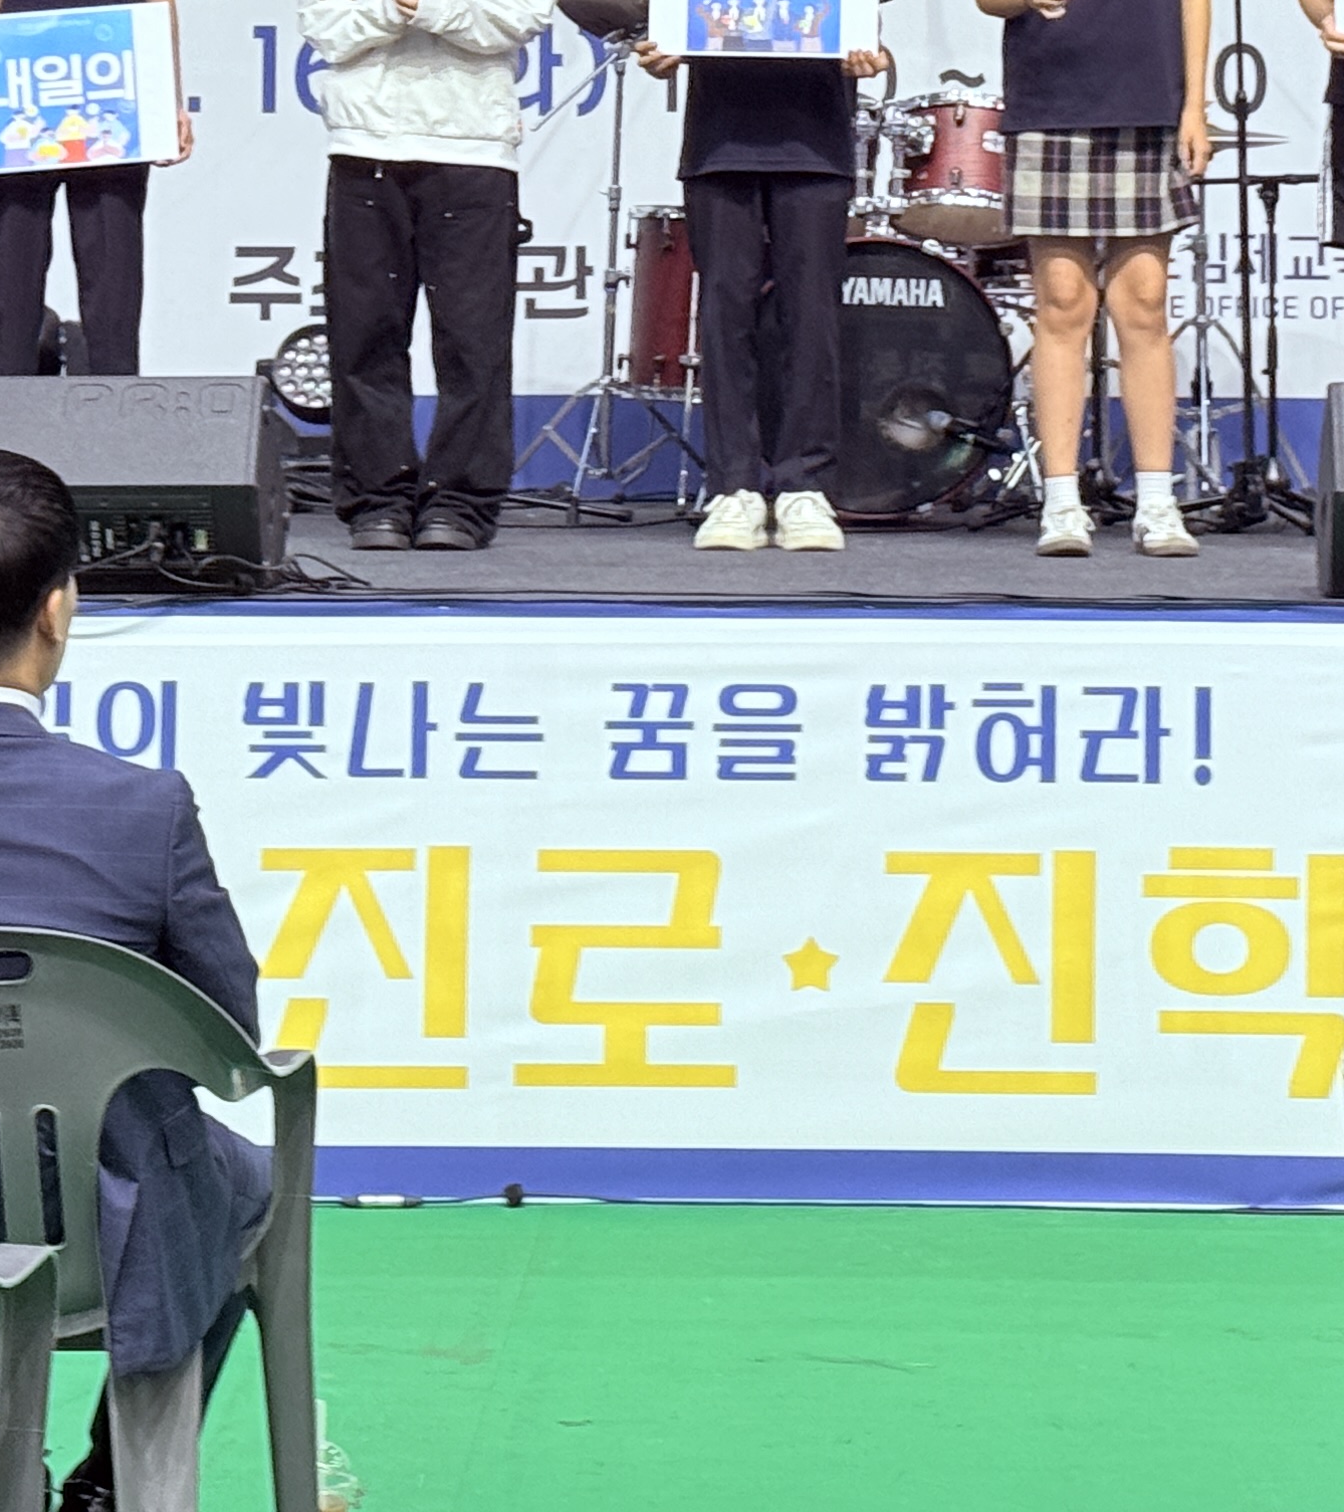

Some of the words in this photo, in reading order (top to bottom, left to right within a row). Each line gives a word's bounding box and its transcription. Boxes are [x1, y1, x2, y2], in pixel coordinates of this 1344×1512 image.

[840, 276, 946, 308] YAMAHA
[242, 681, 544, 779] 빛나는
[605, 682, 804, 782] 꿈을
[863, 683, 1213, 787] 밝혀라!
[253, 844, 737, 1090] 진로
